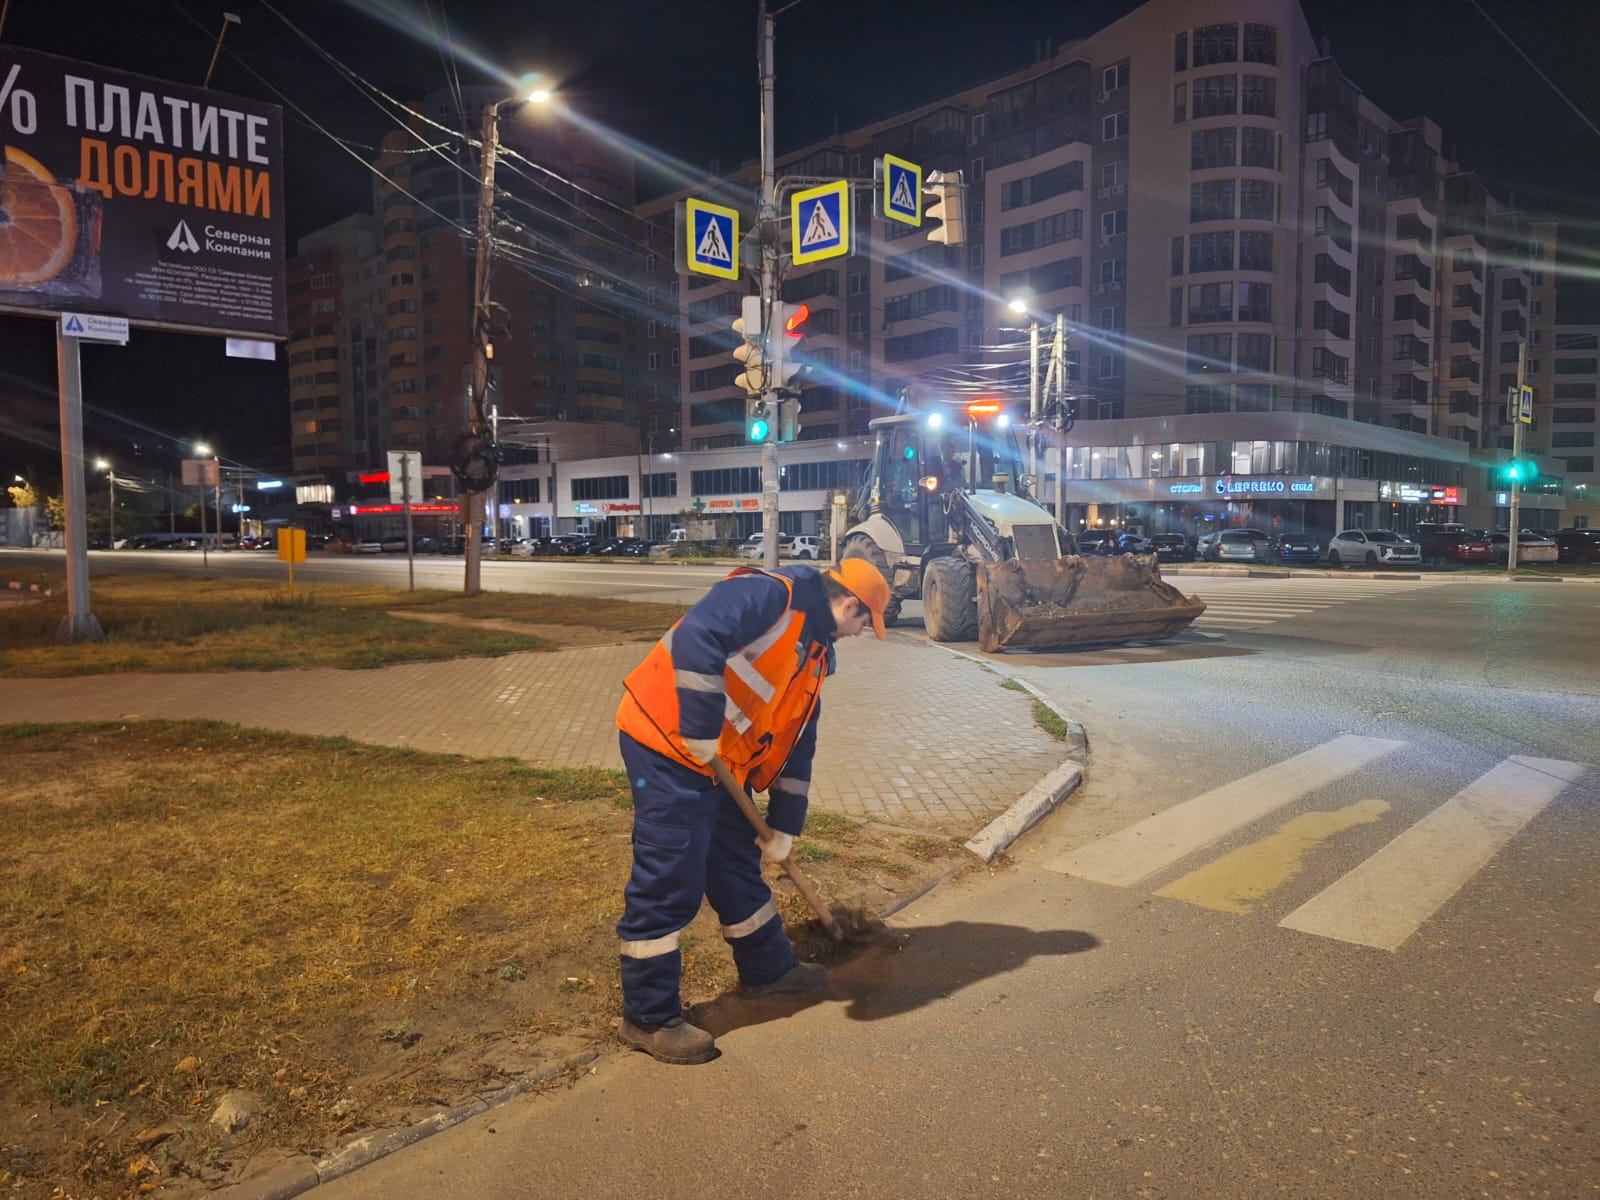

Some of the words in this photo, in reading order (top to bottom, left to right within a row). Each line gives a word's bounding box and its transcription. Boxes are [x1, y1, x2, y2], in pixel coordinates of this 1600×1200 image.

[65, 74, 269, 165] ПЛАТИТЕ
[76, 137, 271, 219] ДОЛЯМИ
[205, 225, 270, 246] Северная
[206, 238, 271, 259] Компания
